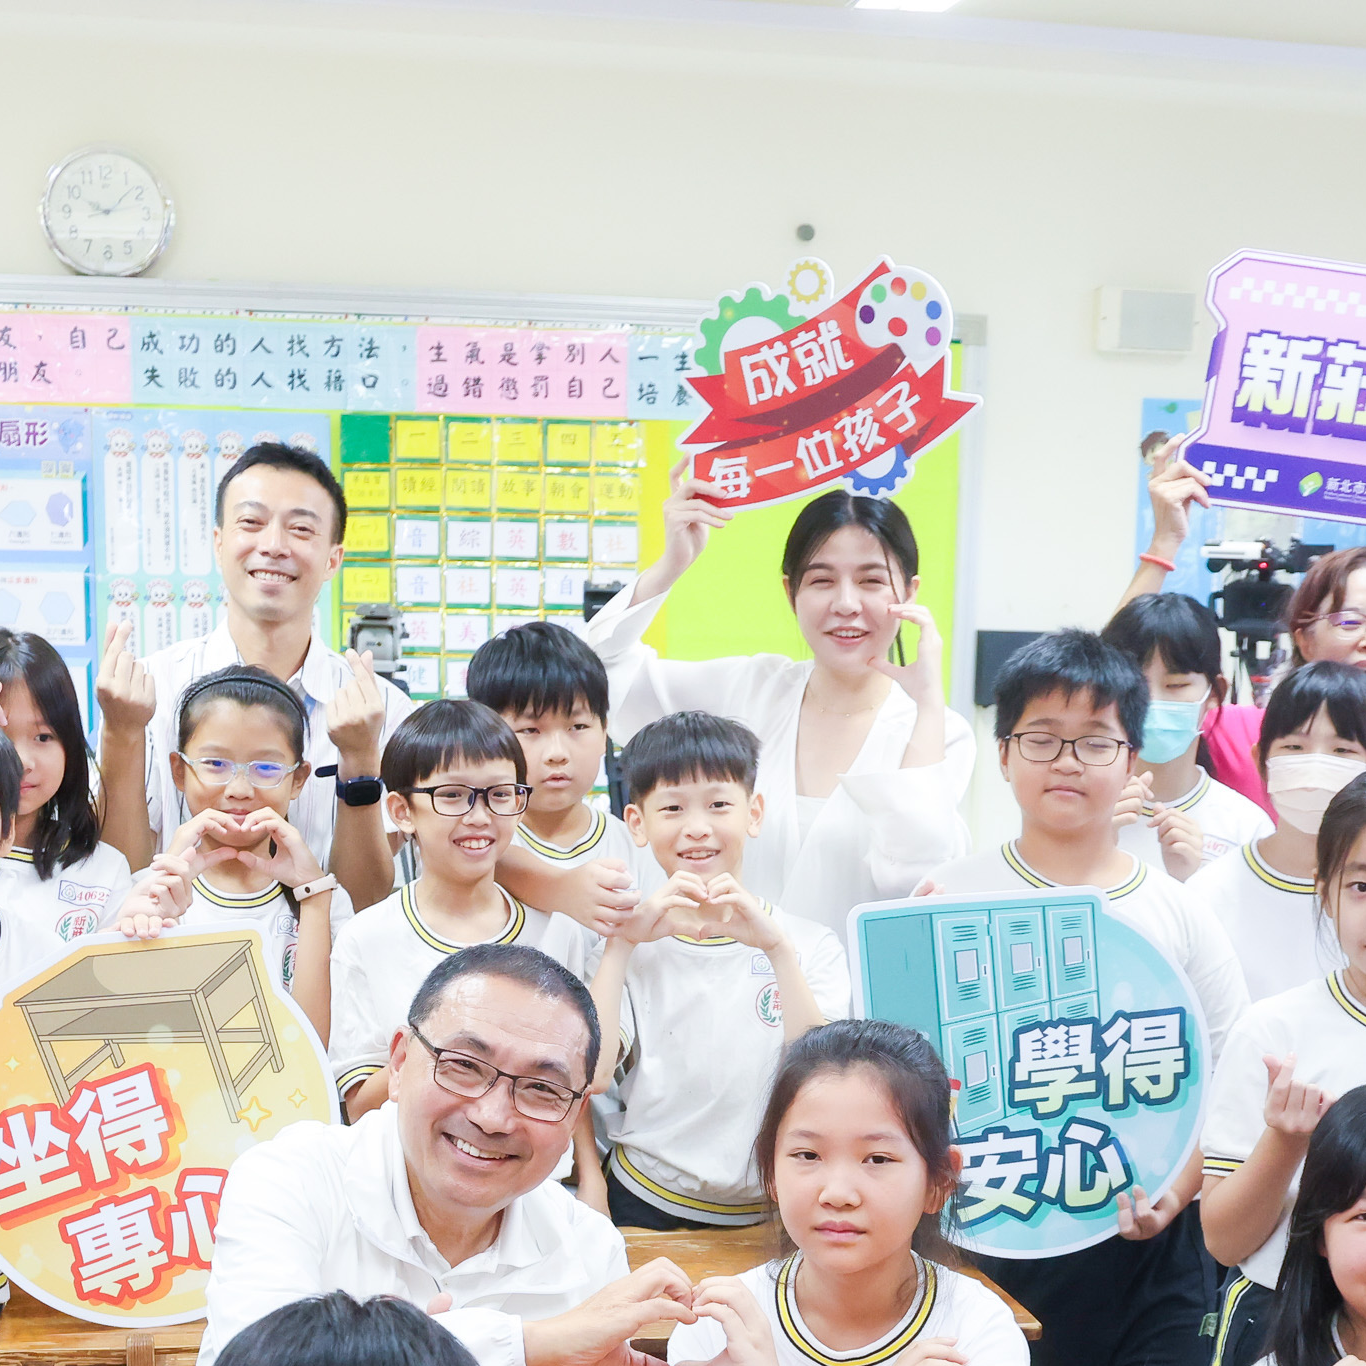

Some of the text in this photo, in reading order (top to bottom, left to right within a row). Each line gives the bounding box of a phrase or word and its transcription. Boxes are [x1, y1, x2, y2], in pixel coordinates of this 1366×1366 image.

[98, 165, 113, 181] 12
[66, 184, 81, 200] 10
[135, 186, 145, 200] 2
[61, 204, 72, 219] 9
[142, 206, 152, 221] 3
[83, 239, 93, 255] 7
[103, 245, 113, 260] 6
[123, 240, 133, 255] 5
[426, 340, 621, 368] 生氣是拿別人
[740, 319, 856, 406] 成就
[426, 373, 621, 400] 過錯懲罰自己
[560, 431, 577, 446] 四
[706, 381, 923, 499] 每一位孩子
[401, 475, 437, 493] 讀經
[501, 477, 537, 498] 故事
[549, 480, 585, 499] 朝會
[407, 526, 428, 549] 音
[507, 528, 527, 550] 英
[409, 574, 429, 598] 音
[508, 576, 528, 598] 英
[1013, 1012, 1188, 1116] 學得
[957, 1122, 1131, 1225] 安心
